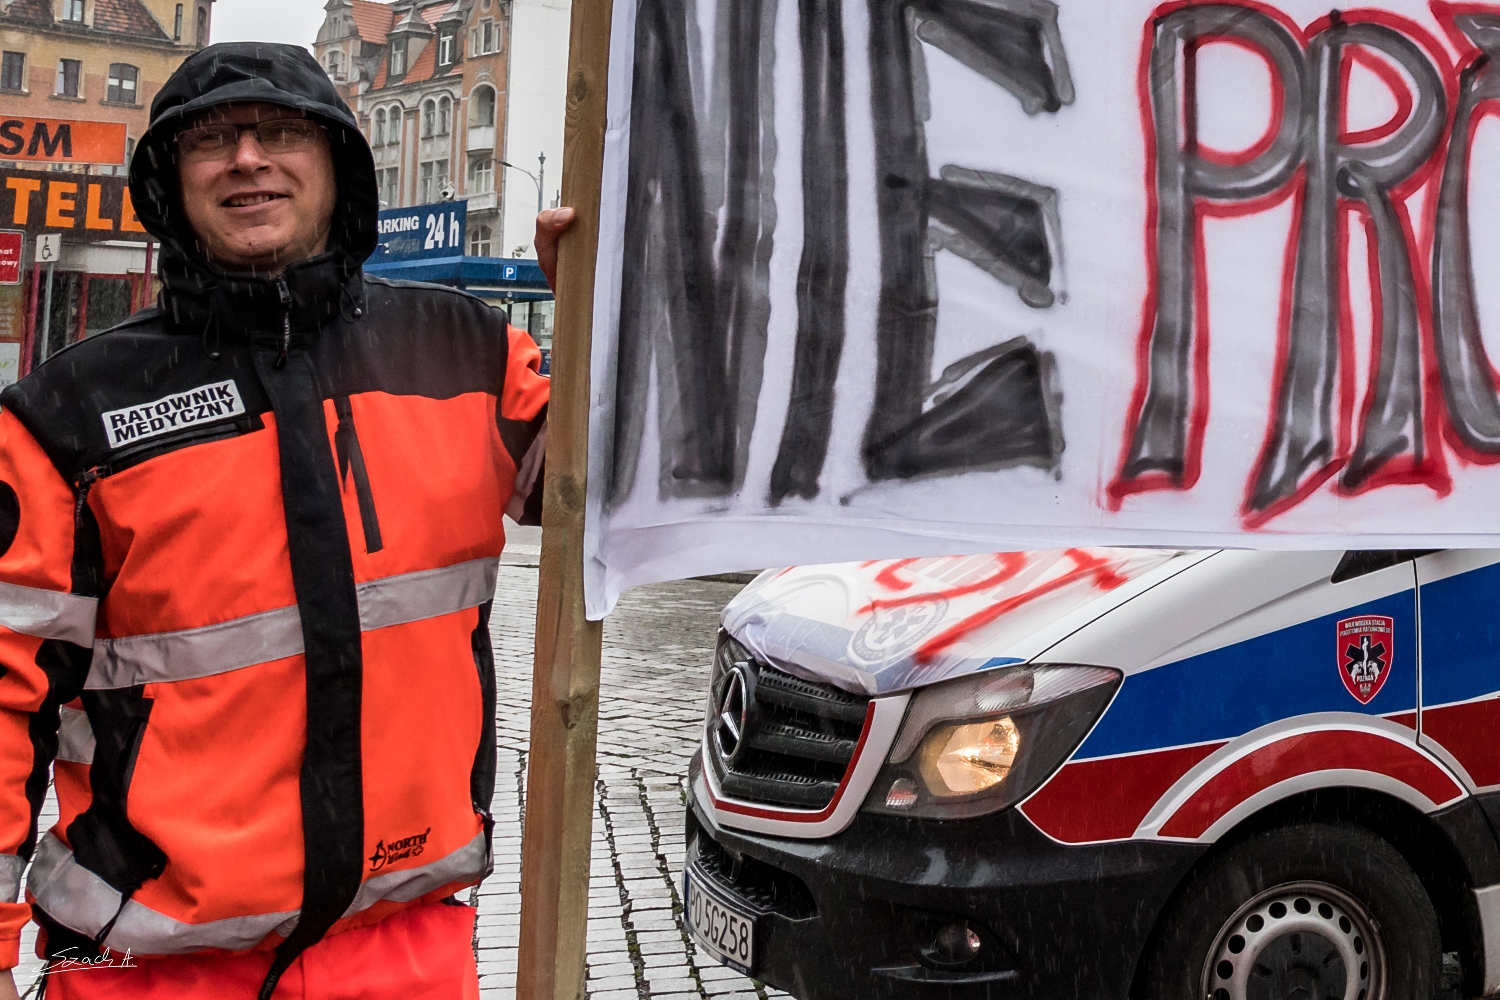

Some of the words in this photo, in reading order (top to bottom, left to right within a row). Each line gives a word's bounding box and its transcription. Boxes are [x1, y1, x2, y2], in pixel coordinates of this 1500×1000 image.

[378, 215, 420, 234] ARKING
[424, 213, 445, 250] 24
[448, 211, 460, 248] h
[110, 384, 234, 429] RATOWNIK
[114, 398, 235, 443] MEDYCZNY
[856, 638, 884, 659] MEDYCZN
[703, 898, 749, 961] 5G258
